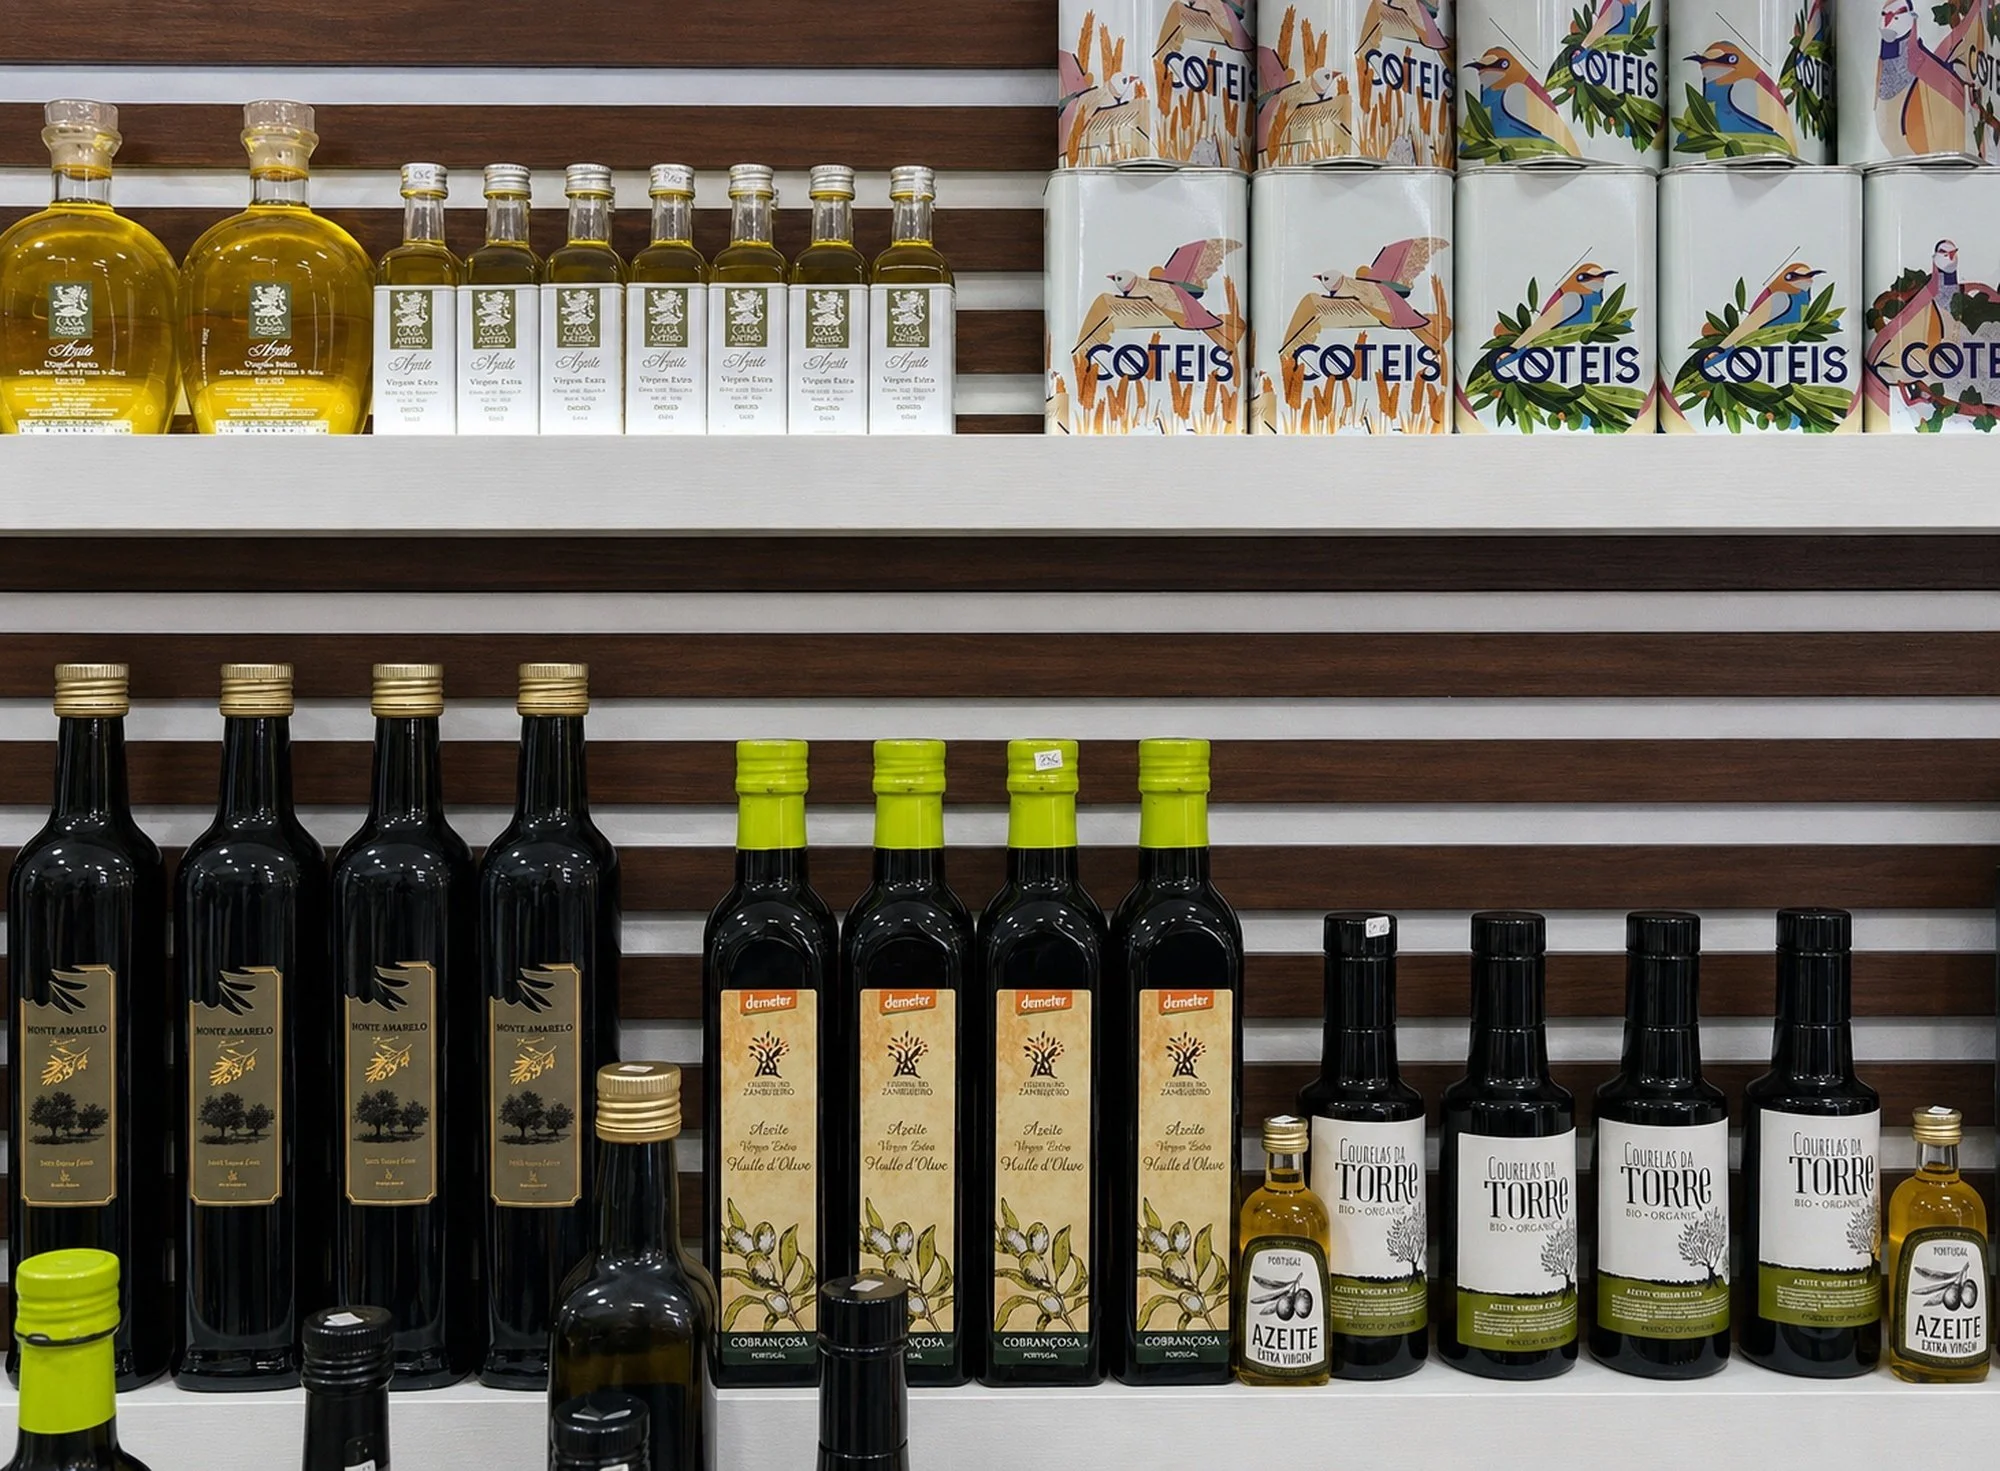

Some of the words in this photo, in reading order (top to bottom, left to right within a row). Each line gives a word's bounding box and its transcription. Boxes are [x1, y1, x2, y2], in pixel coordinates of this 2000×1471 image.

[1086, 343, 1235, 383] COTEIS
[1293, 343, 1441, 383] COTEIS
[1489, 345, 1641, 384] COTEIS
[1699, 345, 1848, 384] COTEIS
[745, 994, 792, 1010] demeter
[884, 993, 931, 1009] demeter
[1020, 994, 1067, 1010] demeter
[1163, 994, 1209, 1010] demeter
[1338, 1206, 1355, 1215] BIO
[1794, 1198, 1812, 1208] BIO
[1625, 1209, 1642, 1219] BIO
[1489, 1222, 1507, 1232] BIO
[1915, 1313, 1981, 1340] AZEITE
[731, 1337, 809, 1349] COBRANÇOSA
[1002, 1337, 1081, 1349] COBRANÇOSA
[1144, 1336, 1220, 1348] COBRANÇOSA
[1252, 1323, 1318, 1351] AZEITE
